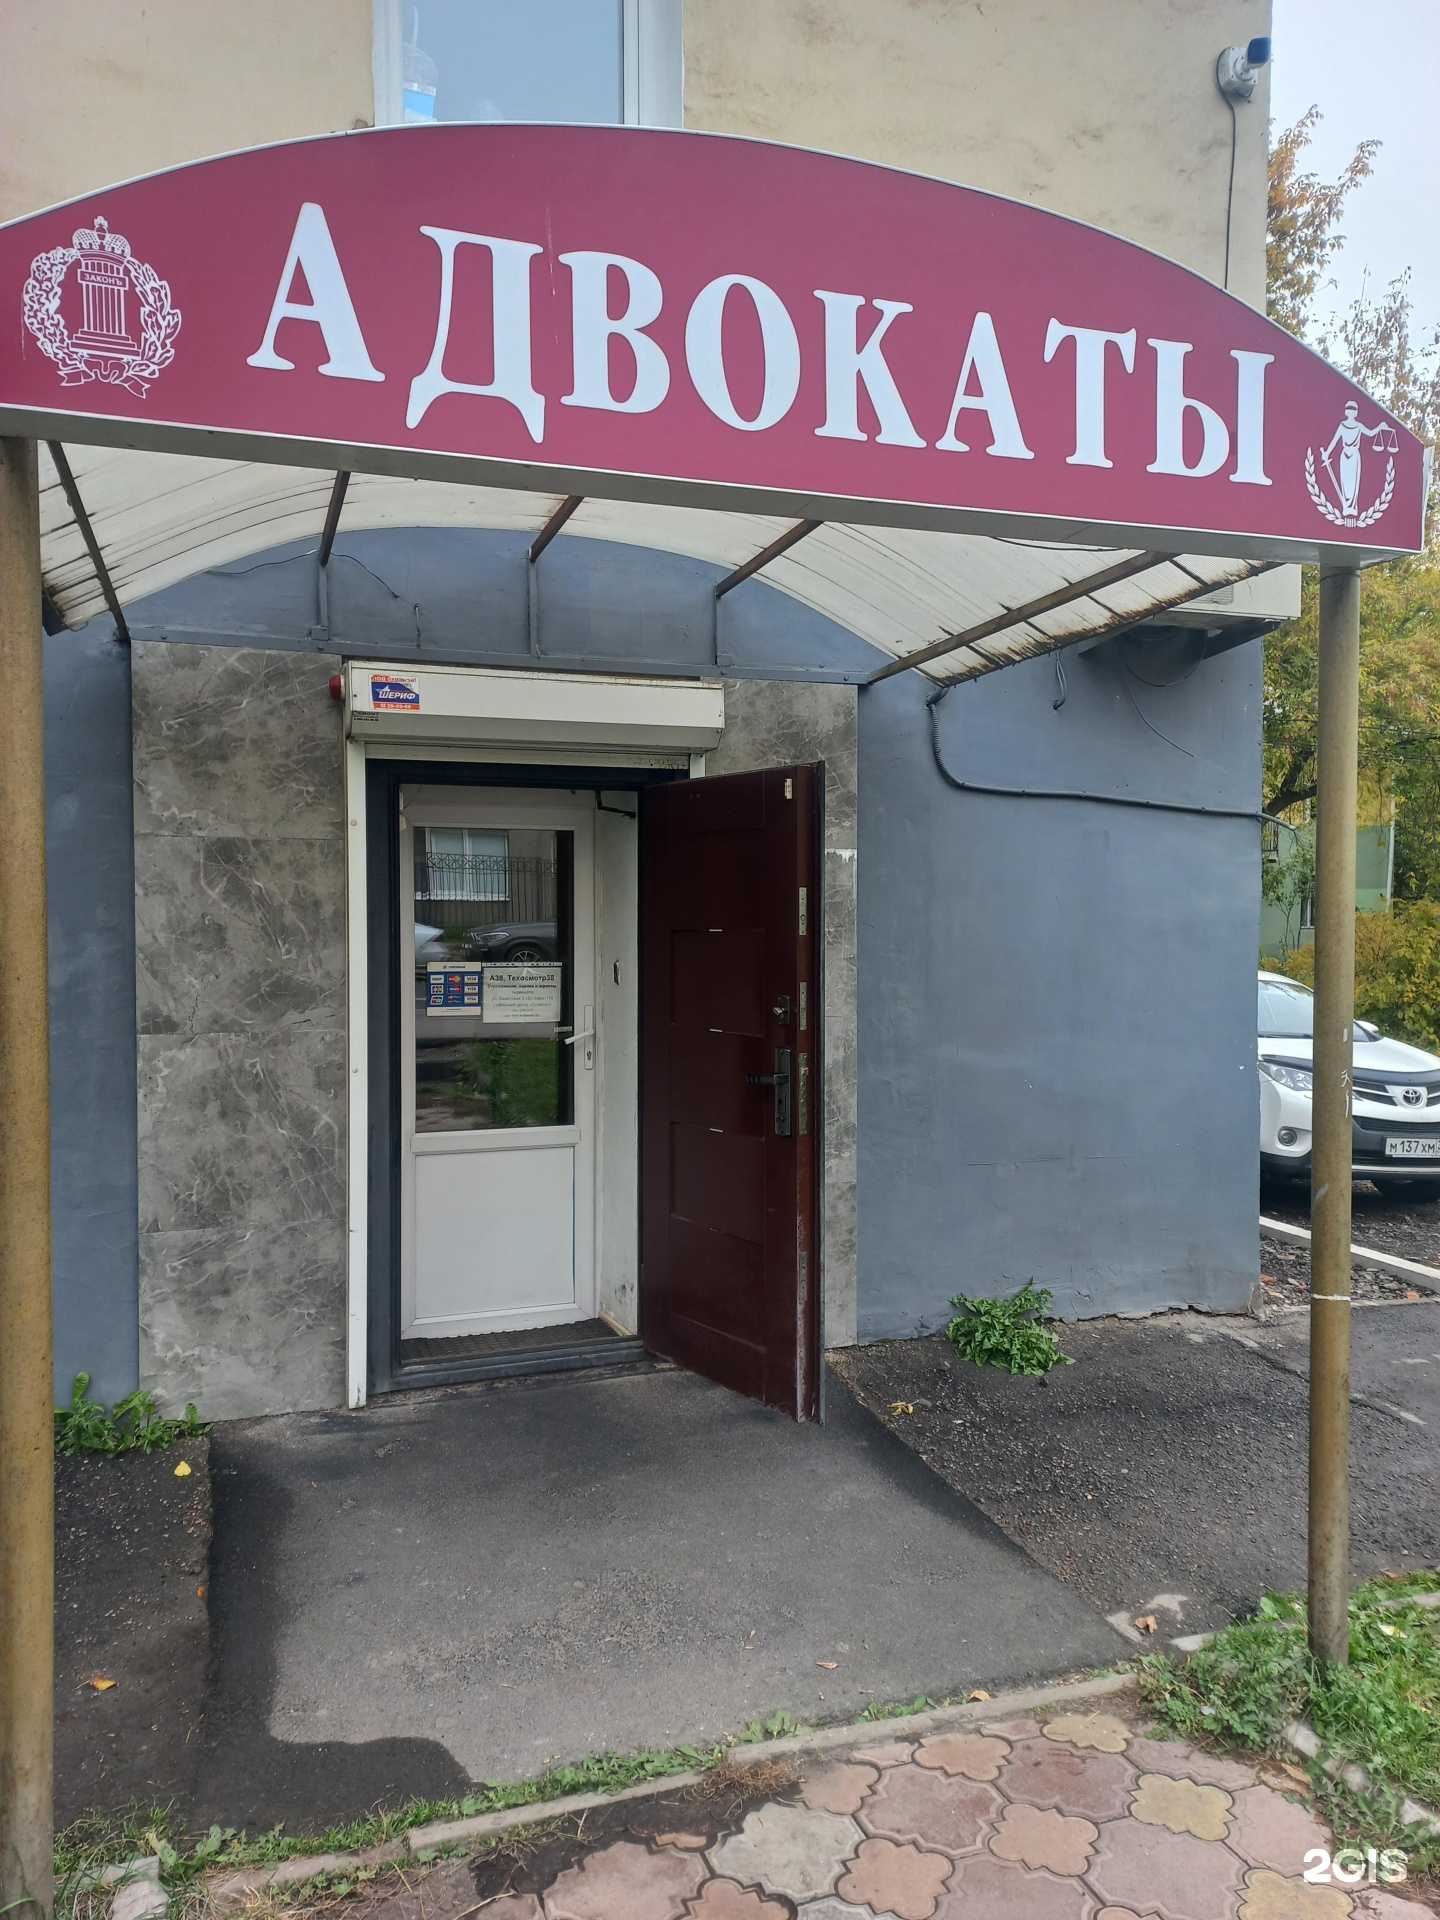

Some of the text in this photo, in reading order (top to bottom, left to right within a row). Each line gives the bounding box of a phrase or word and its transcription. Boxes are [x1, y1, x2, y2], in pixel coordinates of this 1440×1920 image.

[82, 273, 124, 286] ЗАКОНЪ
[246, 201, 1275, 487] АДВОКАТЫ
[378, 690, 416, 700] ШЕРИФ
